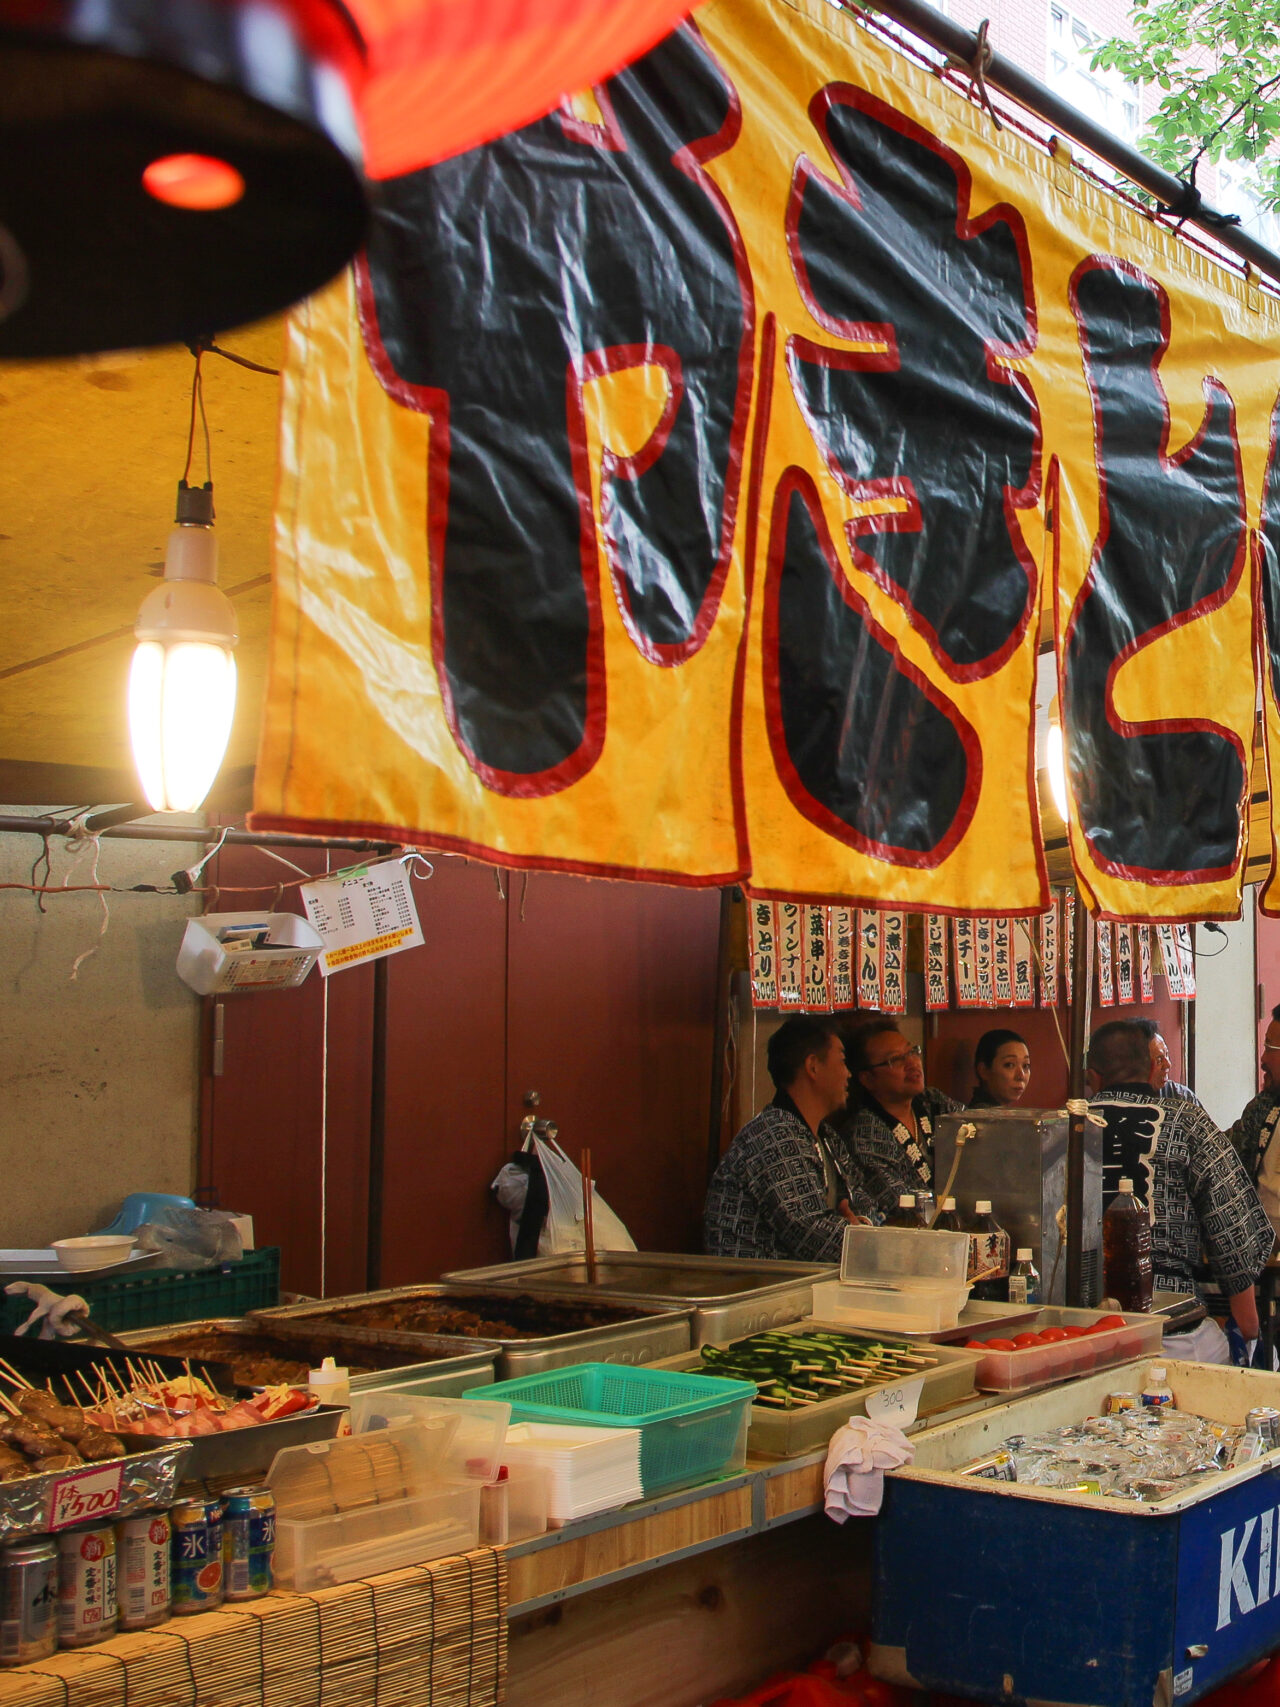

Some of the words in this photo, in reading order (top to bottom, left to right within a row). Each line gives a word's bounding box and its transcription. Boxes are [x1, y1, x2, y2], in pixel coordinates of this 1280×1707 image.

[809, 904, 825, 985] 菜串し
[862, 909, 877, 981] でん
[1044, 904, 1055, 984] フトドリンク
[1119, 924, 1131, 982] 本酒
[1161, 925, 1179, 976] ビール
[182, 1534, 205, 1558] 氷
